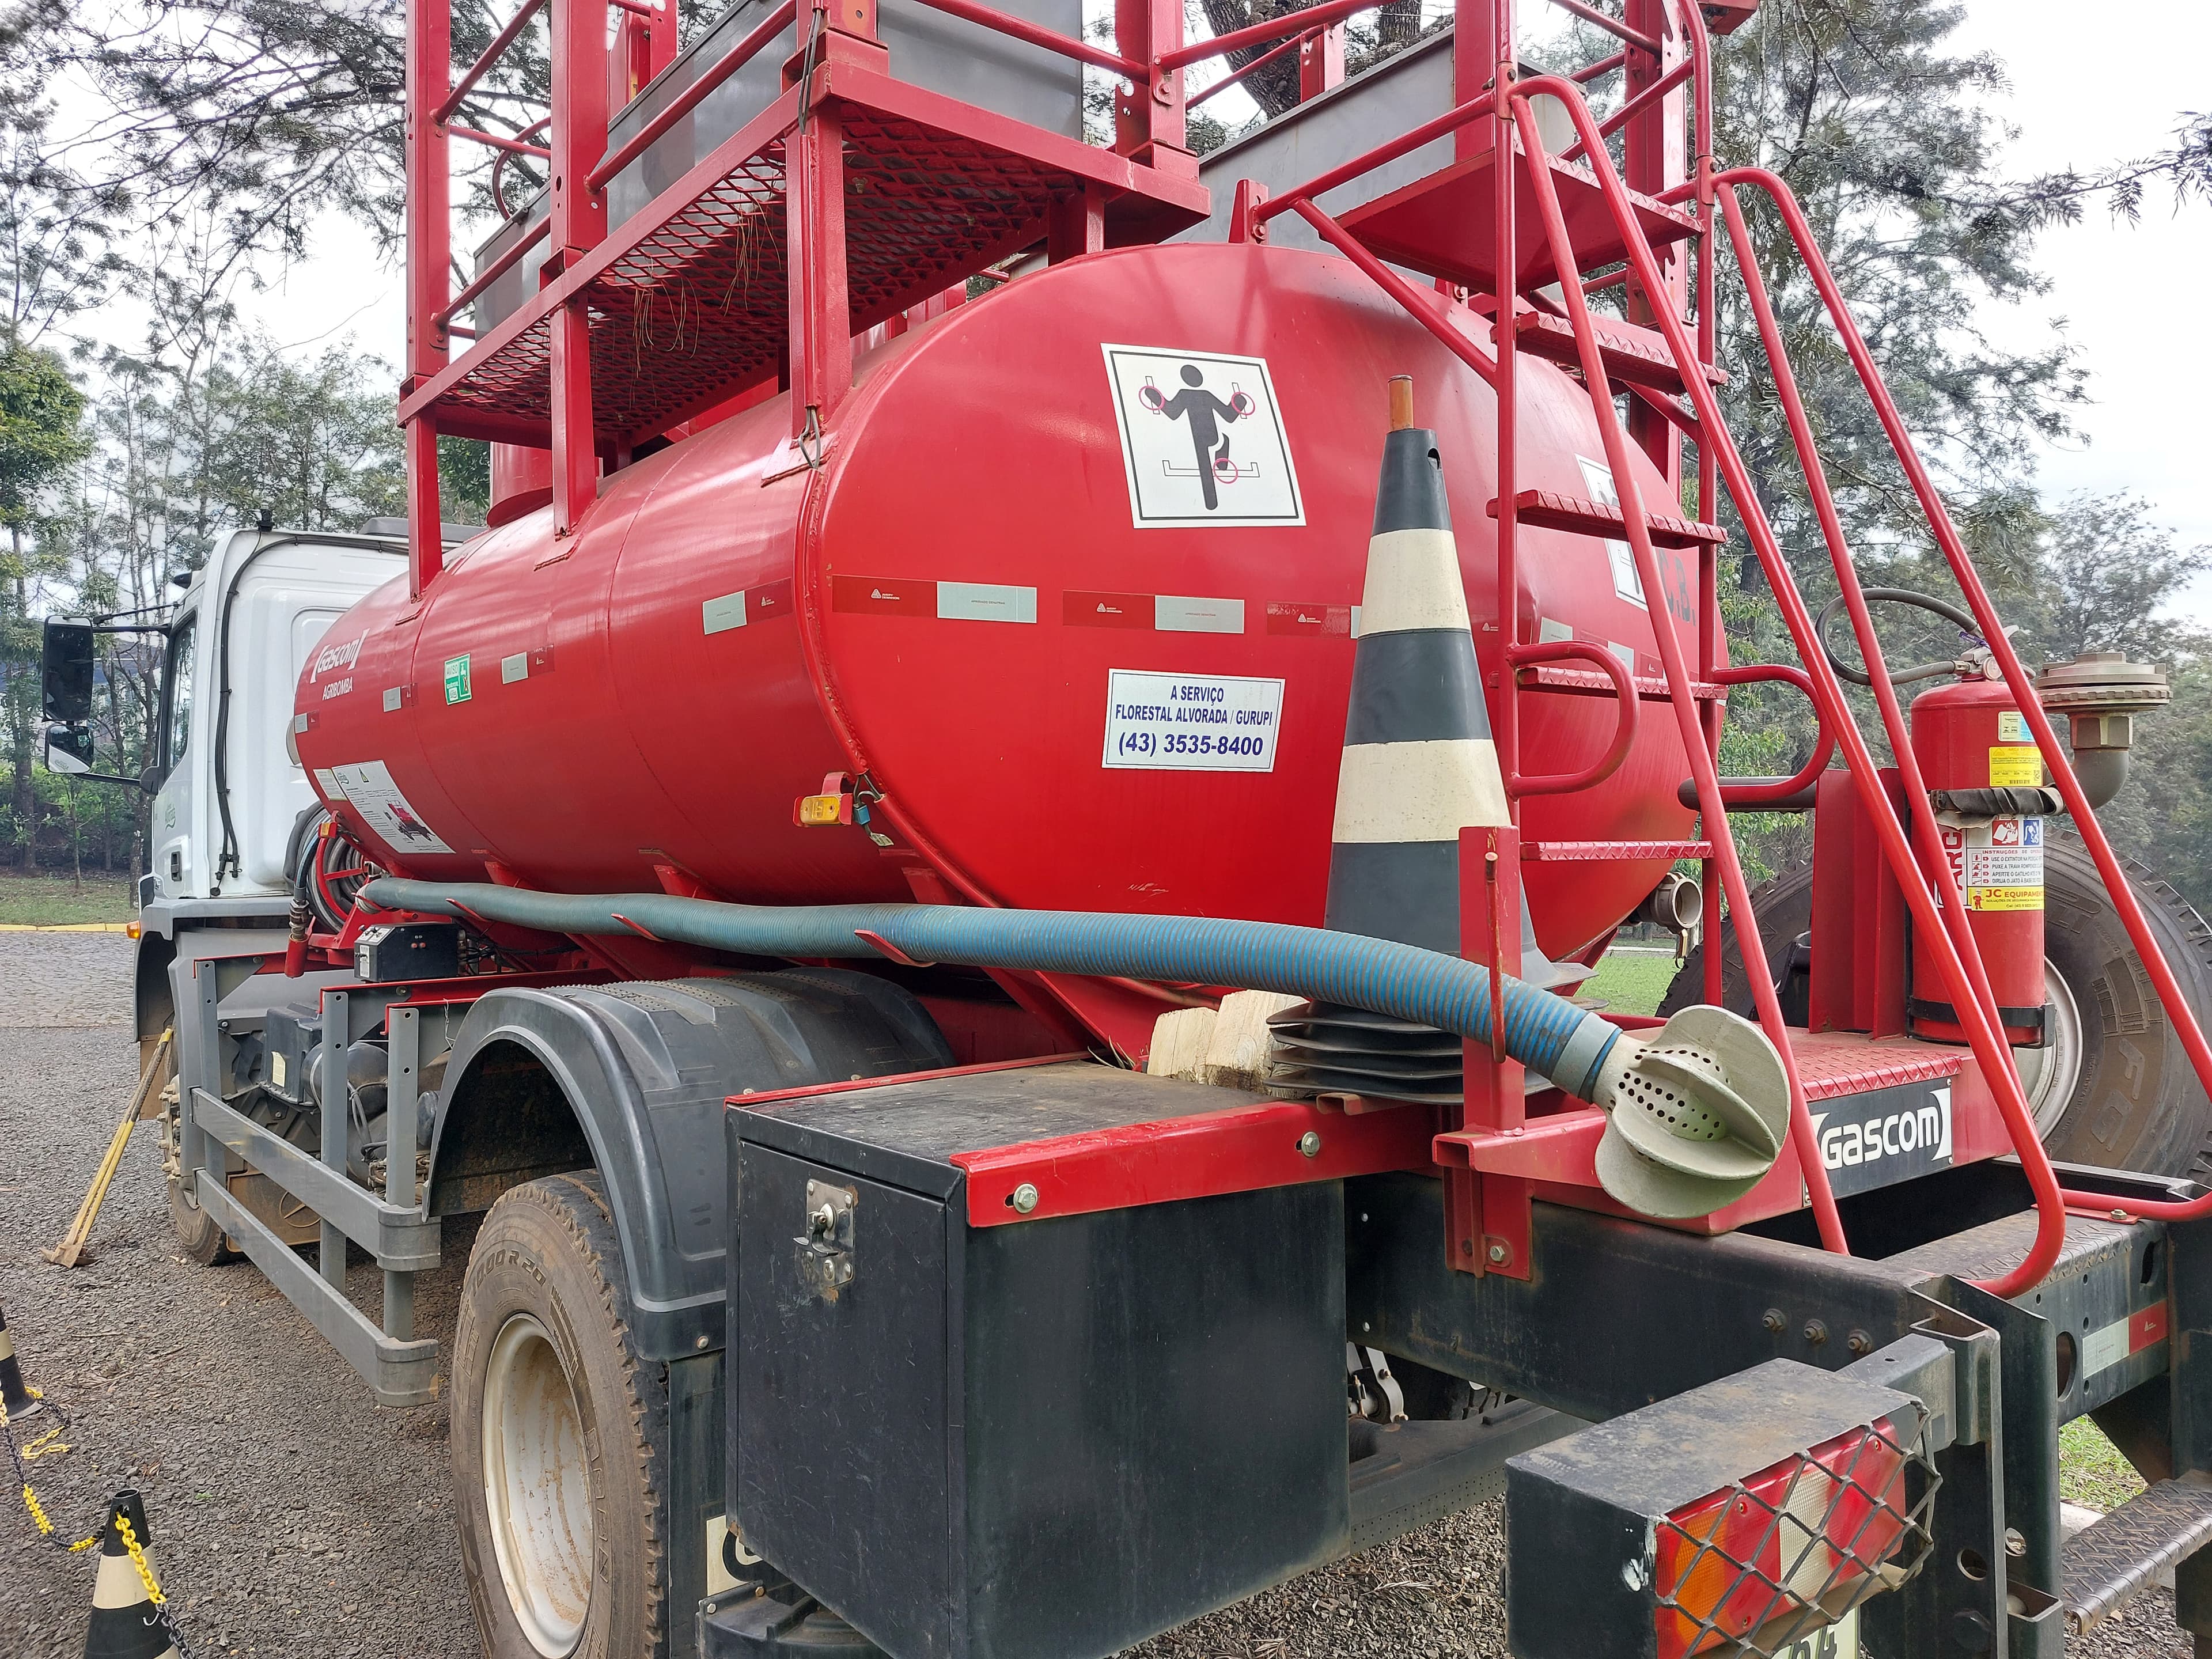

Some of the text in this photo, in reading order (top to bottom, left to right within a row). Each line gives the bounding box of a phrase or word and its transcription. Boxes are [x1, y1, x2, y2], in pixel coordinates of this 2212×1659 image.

[322, 676, 353, 701] AGRIBOMBA
[1170, 685, 1224, 706] A SERVIÇO
[1115, 704, 1273, 726] FLORESTAL ALVORADA / GURUPI
[1119, 732, 1263, 757] (43) 3535-8400
[1985, 889, 2002, 897] JC
[1821, 1106, 1940, 1171] Gascom
[509, 1249, 521, 1266] R
[521, 1257, 547, 1286] 20
